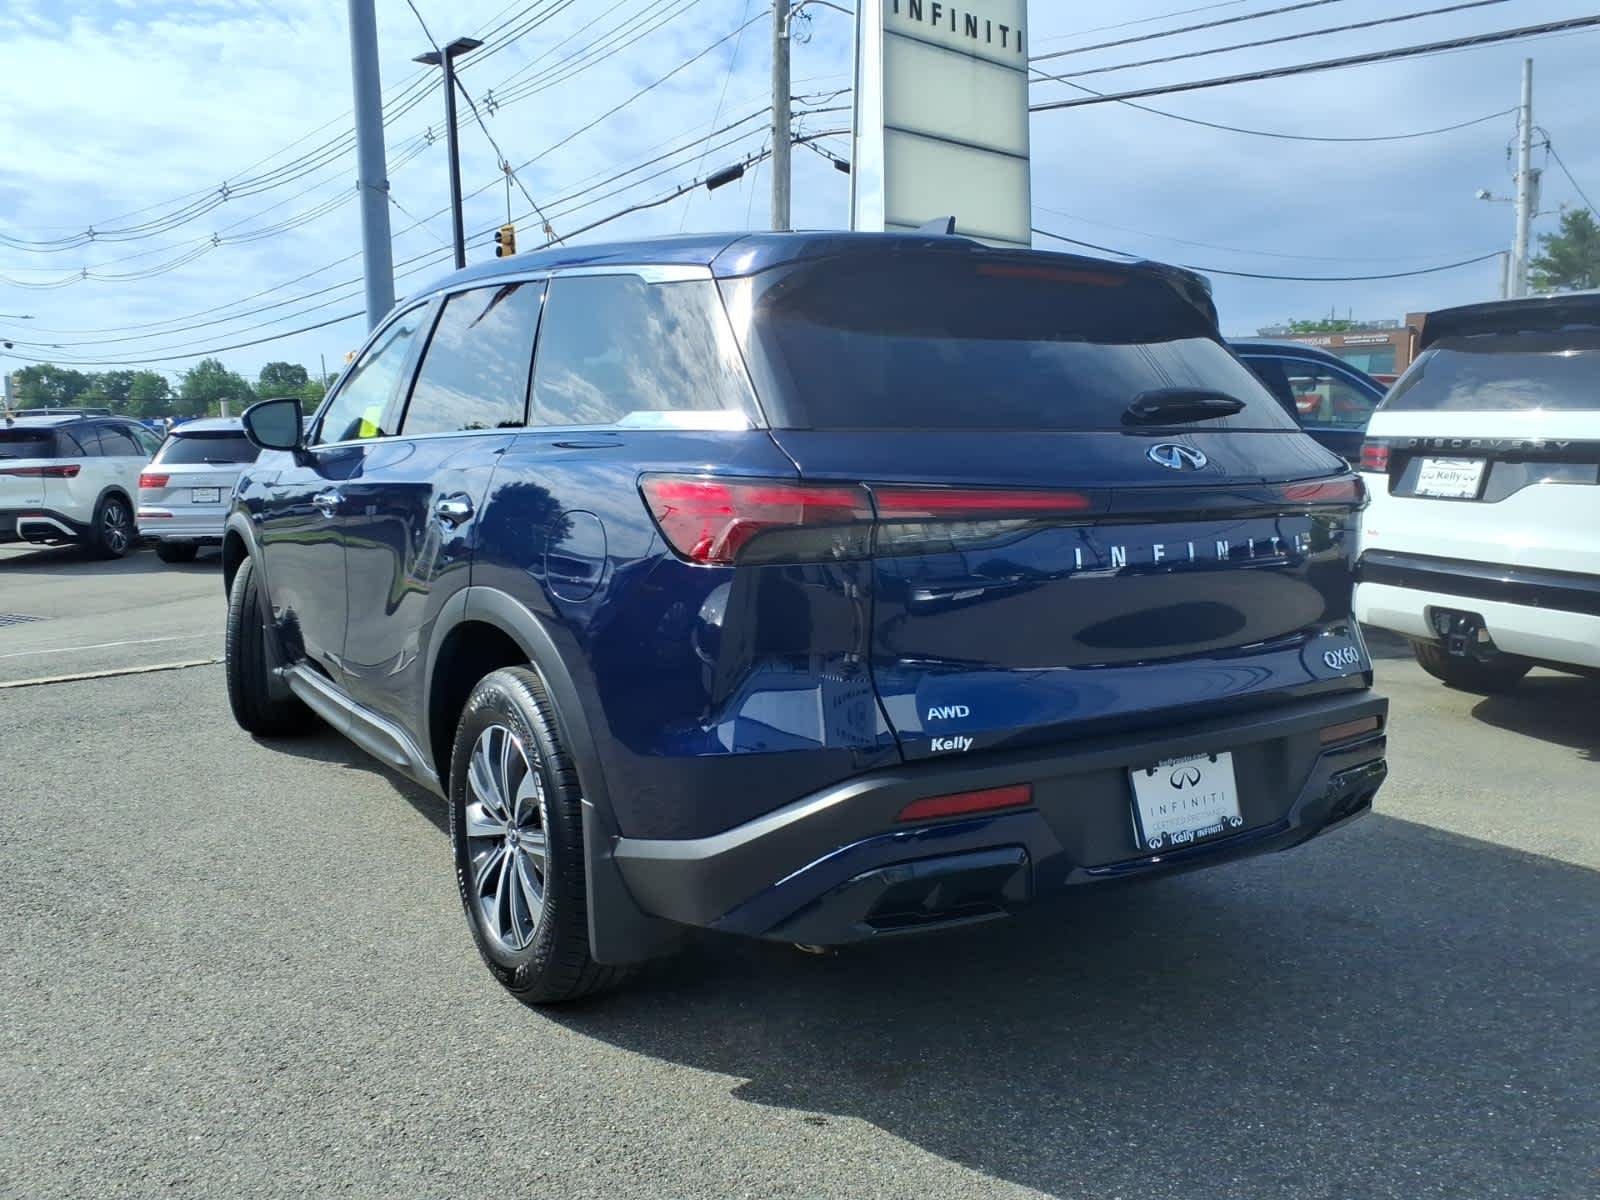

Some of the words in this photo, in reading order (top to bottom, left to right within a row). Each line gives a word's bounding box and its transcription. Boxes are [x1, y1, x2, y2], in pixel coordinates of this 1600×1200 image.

[893, 0, 1022, 53] INFINITI
[1436, 469, 1463, 483] Kelly
[1074, 536, 1301, 568] INFINITI
[1324, 646, 1359, 670] QX60
[927, 704, 970, 721] AWD
[931, 736, 974, 752] Kelly
[1150, 791, 1225, 817] INFINITI
[1170, 830, 1194, 846] Kelly
